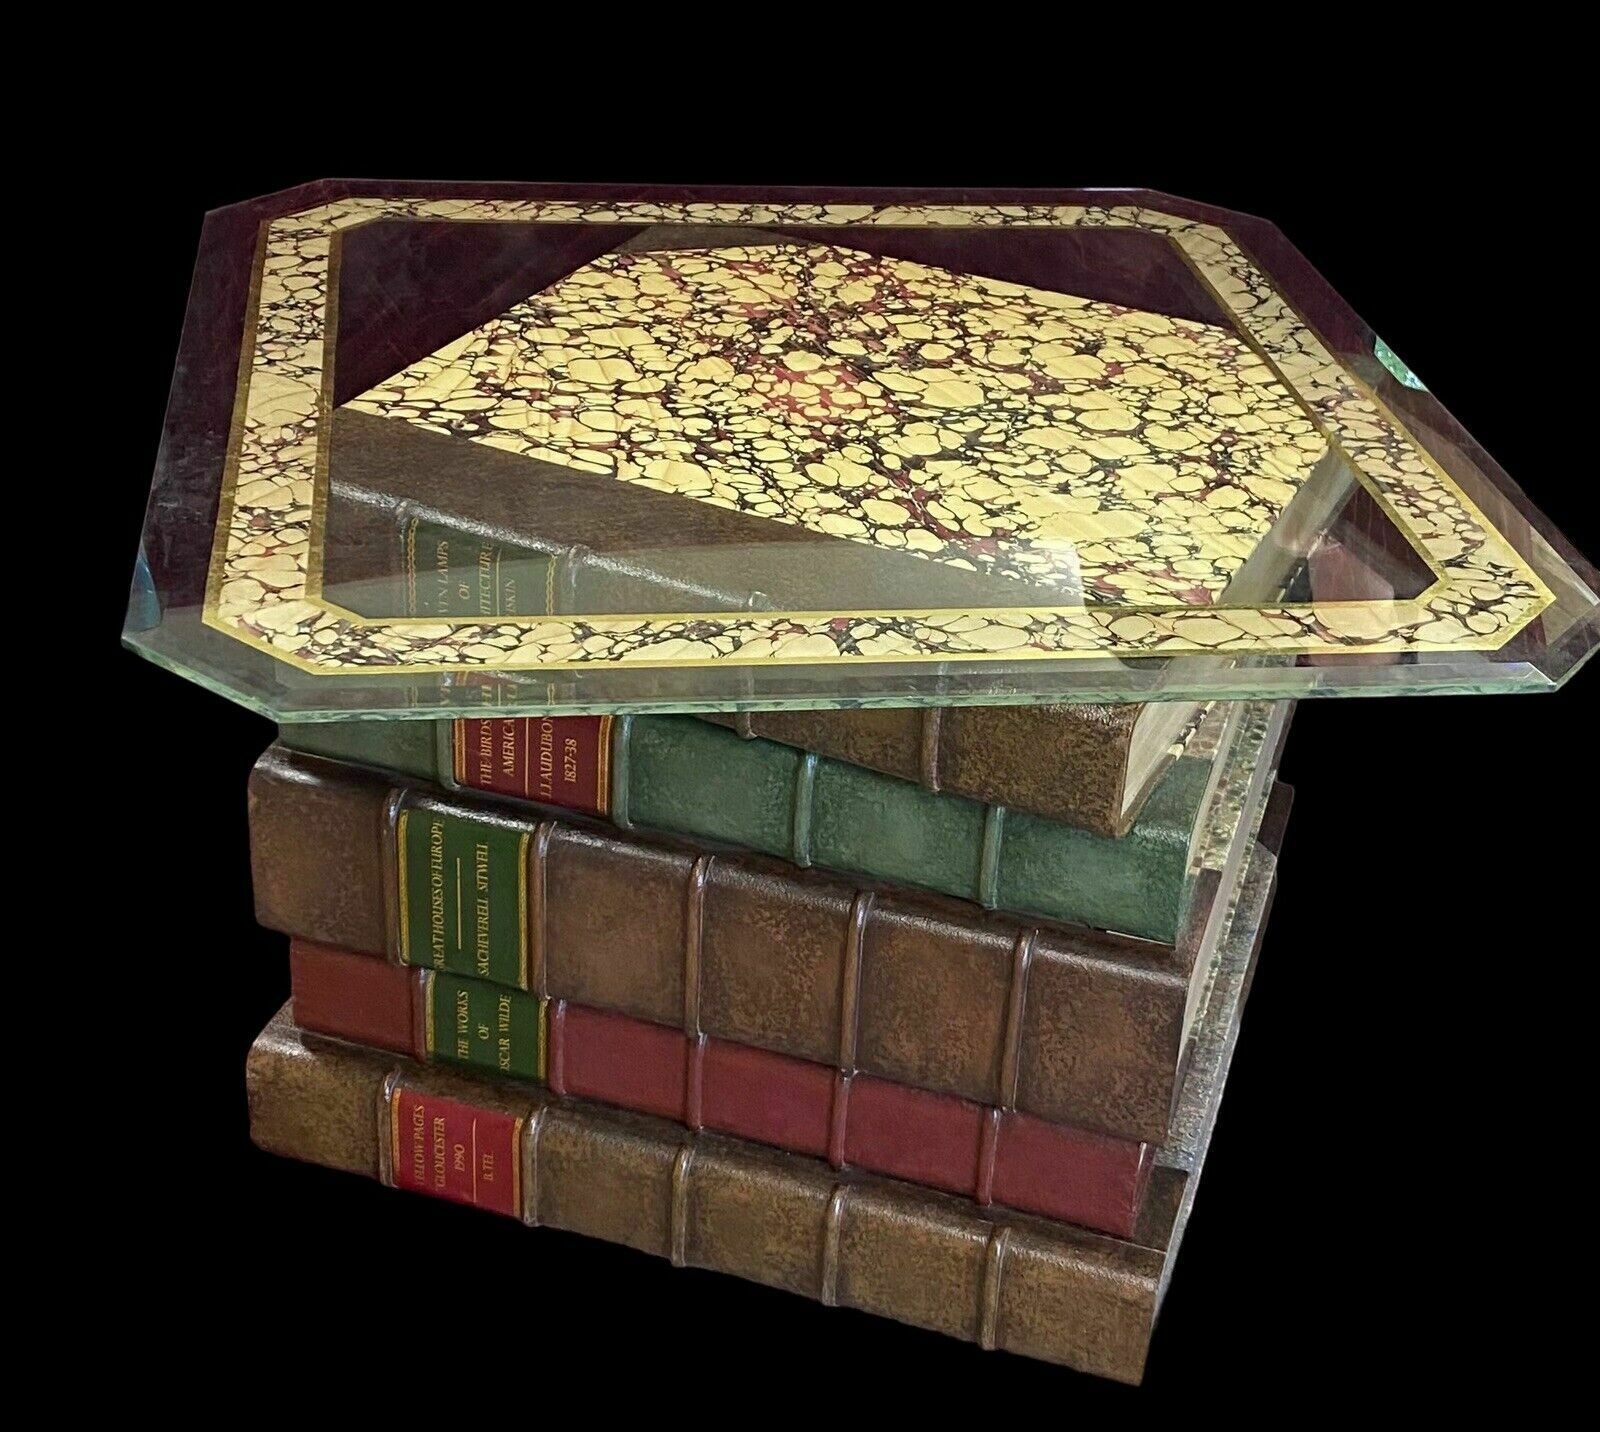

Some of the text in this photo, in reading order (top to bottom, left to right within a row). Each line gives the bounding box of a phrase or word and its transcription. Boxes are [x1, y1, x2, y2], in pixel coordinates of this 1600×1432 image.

[436, 540, 448, 585] LAMPS
[478, 541, 493, 614] ITECTURE
[458, 581, 470, 600] OF
[504, 578, 516, 613] SKIN
[479, 719, 492, 758] BIRDS
[503, 718, 515, 776] AMERICA
[480, 760, 492, 785] THE
[565, 738, 577, 783] 1827-38
[430, 820, 444, 868] EUROPE
[431, 869, 444, 887] OF
[431, 888, 444, 934] HOUSES
[476, 842, 489, 976] SACHEVERELL SITWELL
[457, 990, 469, 1060] THE WORKS
[478, 1023, 490, 1041] OF
[499, 994, 511, 1033] WILDE
[413, 1104, 425, 1141] PAGES
[433, 1117, 445, 1188] GLOUCESTER
[454, 1144, 465, 1172] 1990
